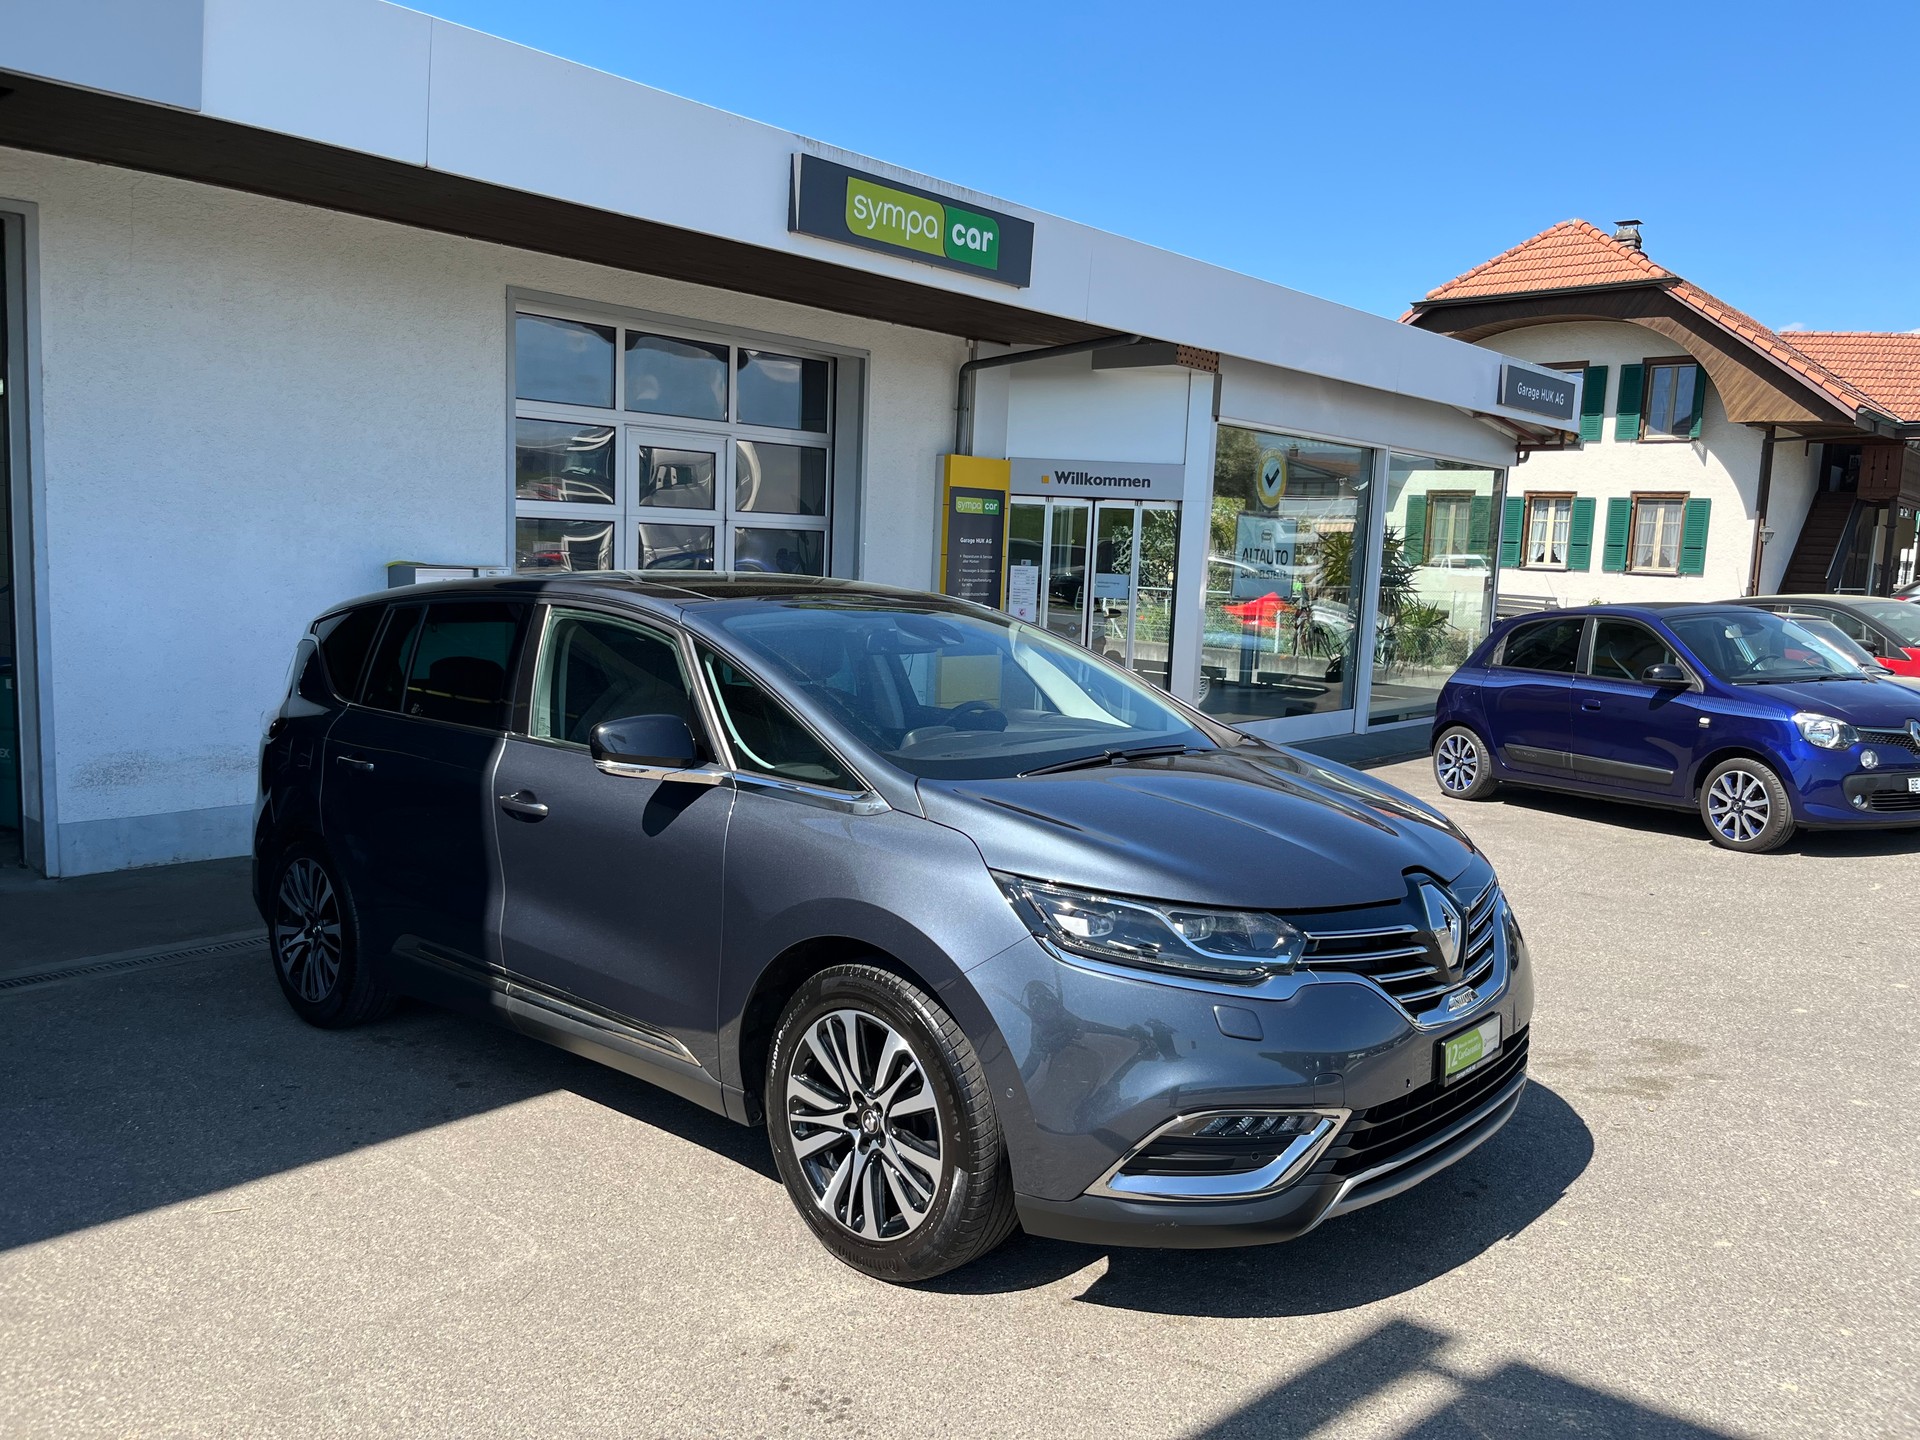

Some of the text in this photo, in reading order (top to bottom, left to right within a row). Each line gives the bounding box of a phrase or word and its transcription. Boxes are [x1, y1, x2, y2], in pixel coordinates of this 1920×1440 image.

[853, 194, 994, 252] sympa car
[1517, 382, 1564, 406] Garage HUK AG
[1054, 470, 1151, 488] Willkommen
[957, 500, 998, 511] sympa car
[959, 537, 975, 545] Garage
[1242, 548, 1289, 566] ALTAUTO
[1447, 1043, 1459, 1069] 12
